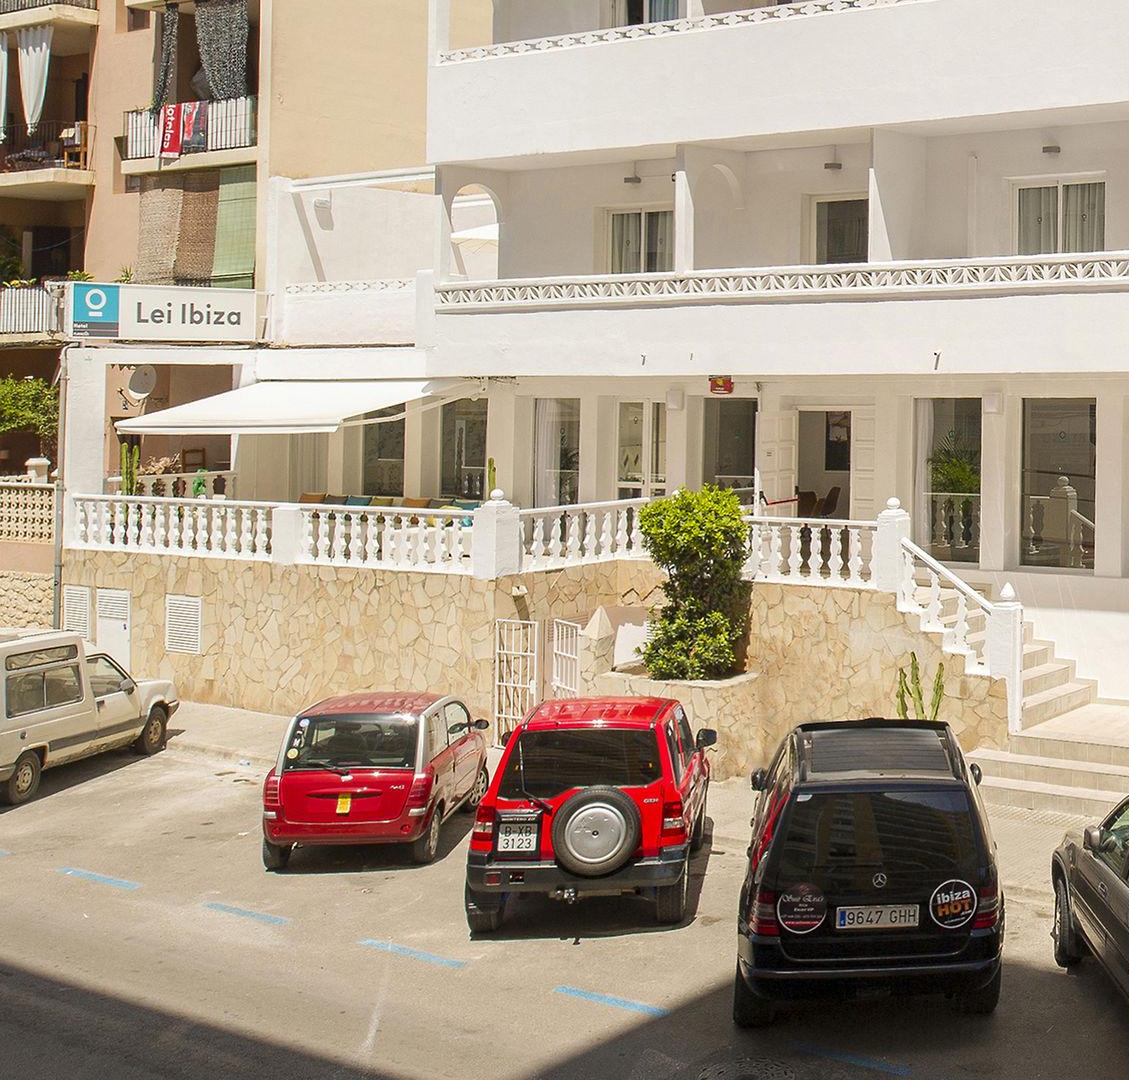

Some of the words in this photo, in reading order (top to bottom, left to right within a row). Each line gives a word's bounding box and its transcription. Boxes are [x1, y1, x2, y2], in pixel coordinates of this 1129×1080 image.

[136, 302, 172, 324] Lei
[181, 303, 242, 326] Ibiza
[502, 838, 532, 849] 3123
[936, 889, 971, 905] ibiza
[937, 898, 971, 917] HOT
[846, 910, 883, 925] 9647
[889, 908, 917, 924] GHH
